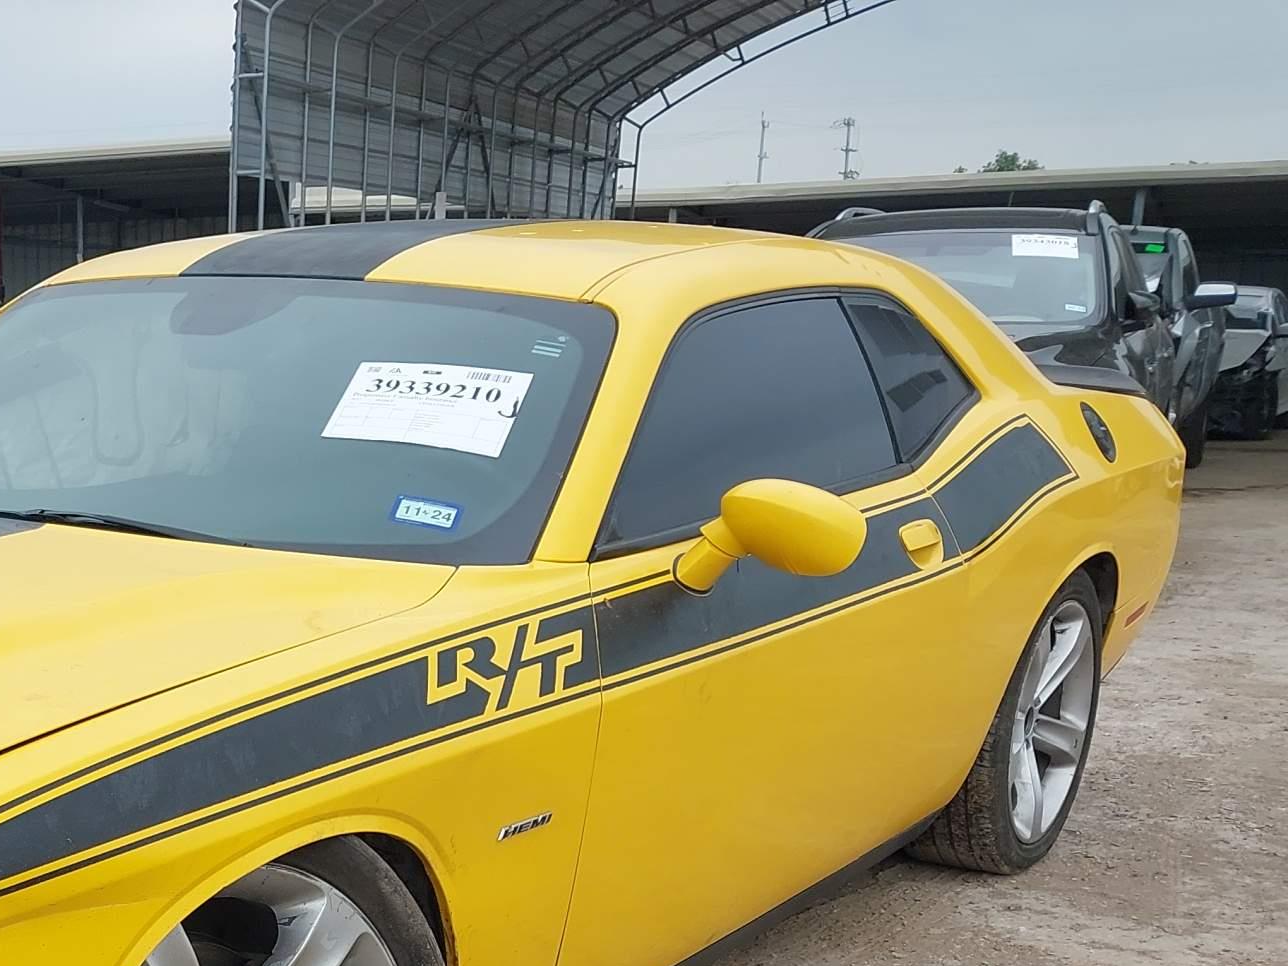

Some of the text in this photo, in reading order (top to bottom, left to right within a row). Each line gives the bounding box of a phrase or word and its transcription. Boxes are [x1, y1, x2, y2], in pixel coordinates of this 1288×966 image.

[365, 377, 502, 404] 39339210
[427, 615, 583, 716] R/T
[497, 811, 553, 841] HEMI
